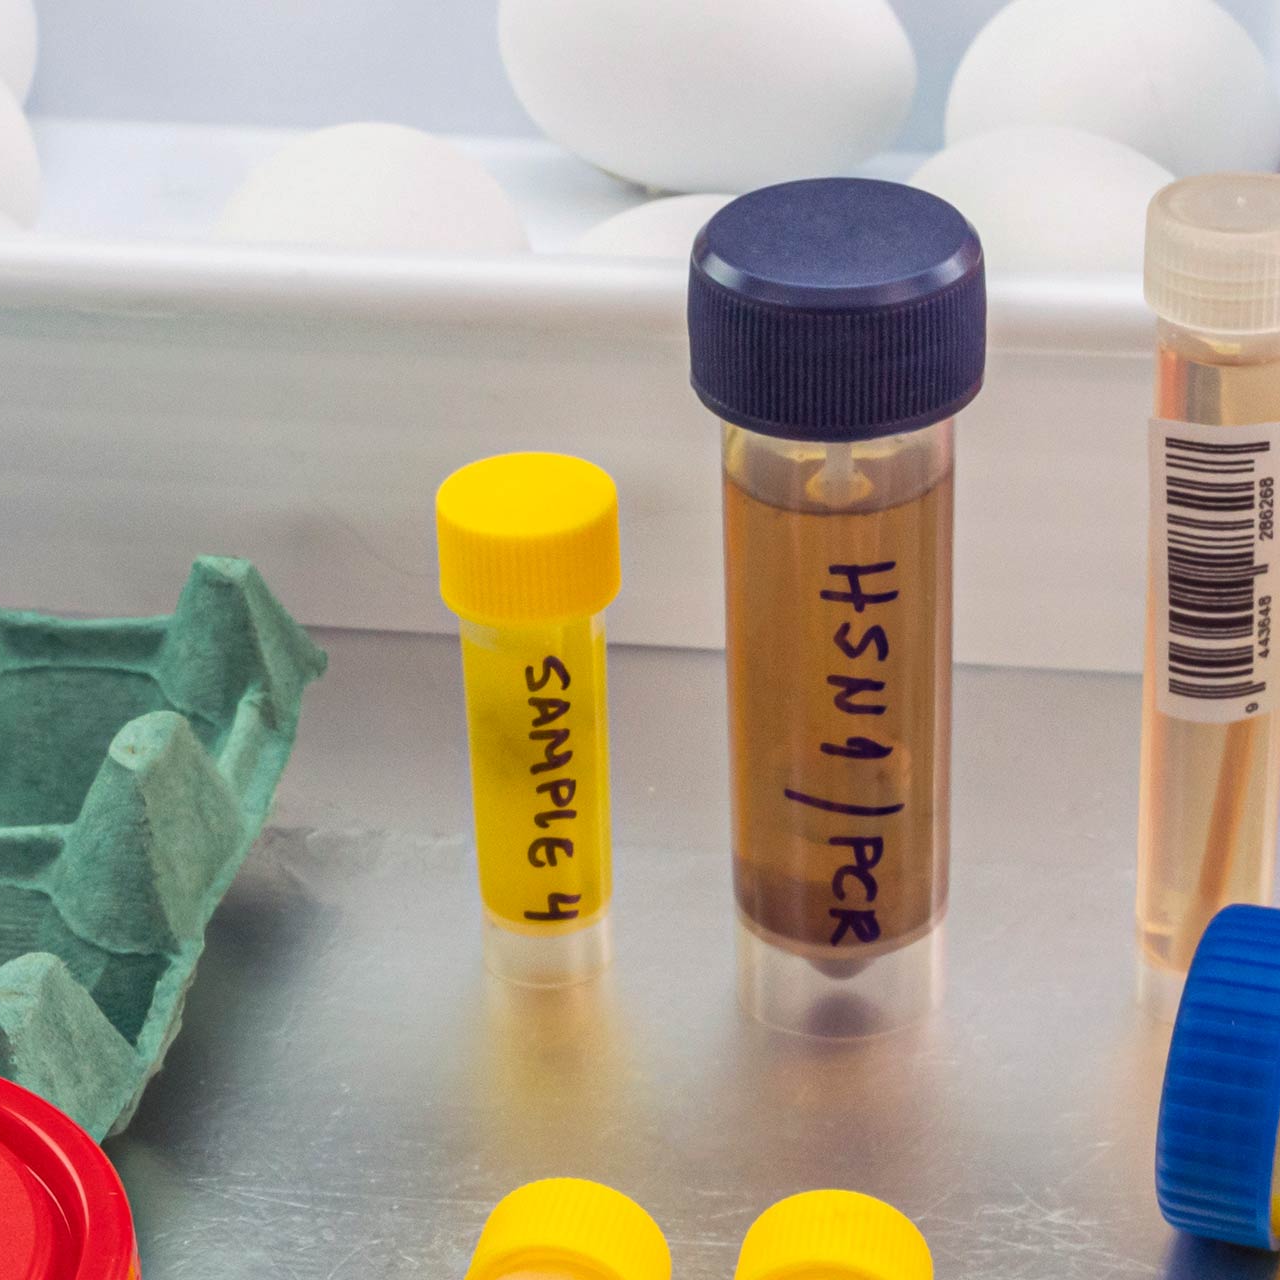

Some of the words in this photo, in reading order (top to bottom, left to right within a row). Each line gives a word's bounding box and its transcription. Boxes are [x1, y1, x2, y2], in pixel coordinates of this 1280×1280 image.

[1258, 476, 1275, 541] 286268
[1257, 595, 1272, 658] 443648
[524, 655, 578, 868] SAMPLE
[523, 892, 581, 922] 4
